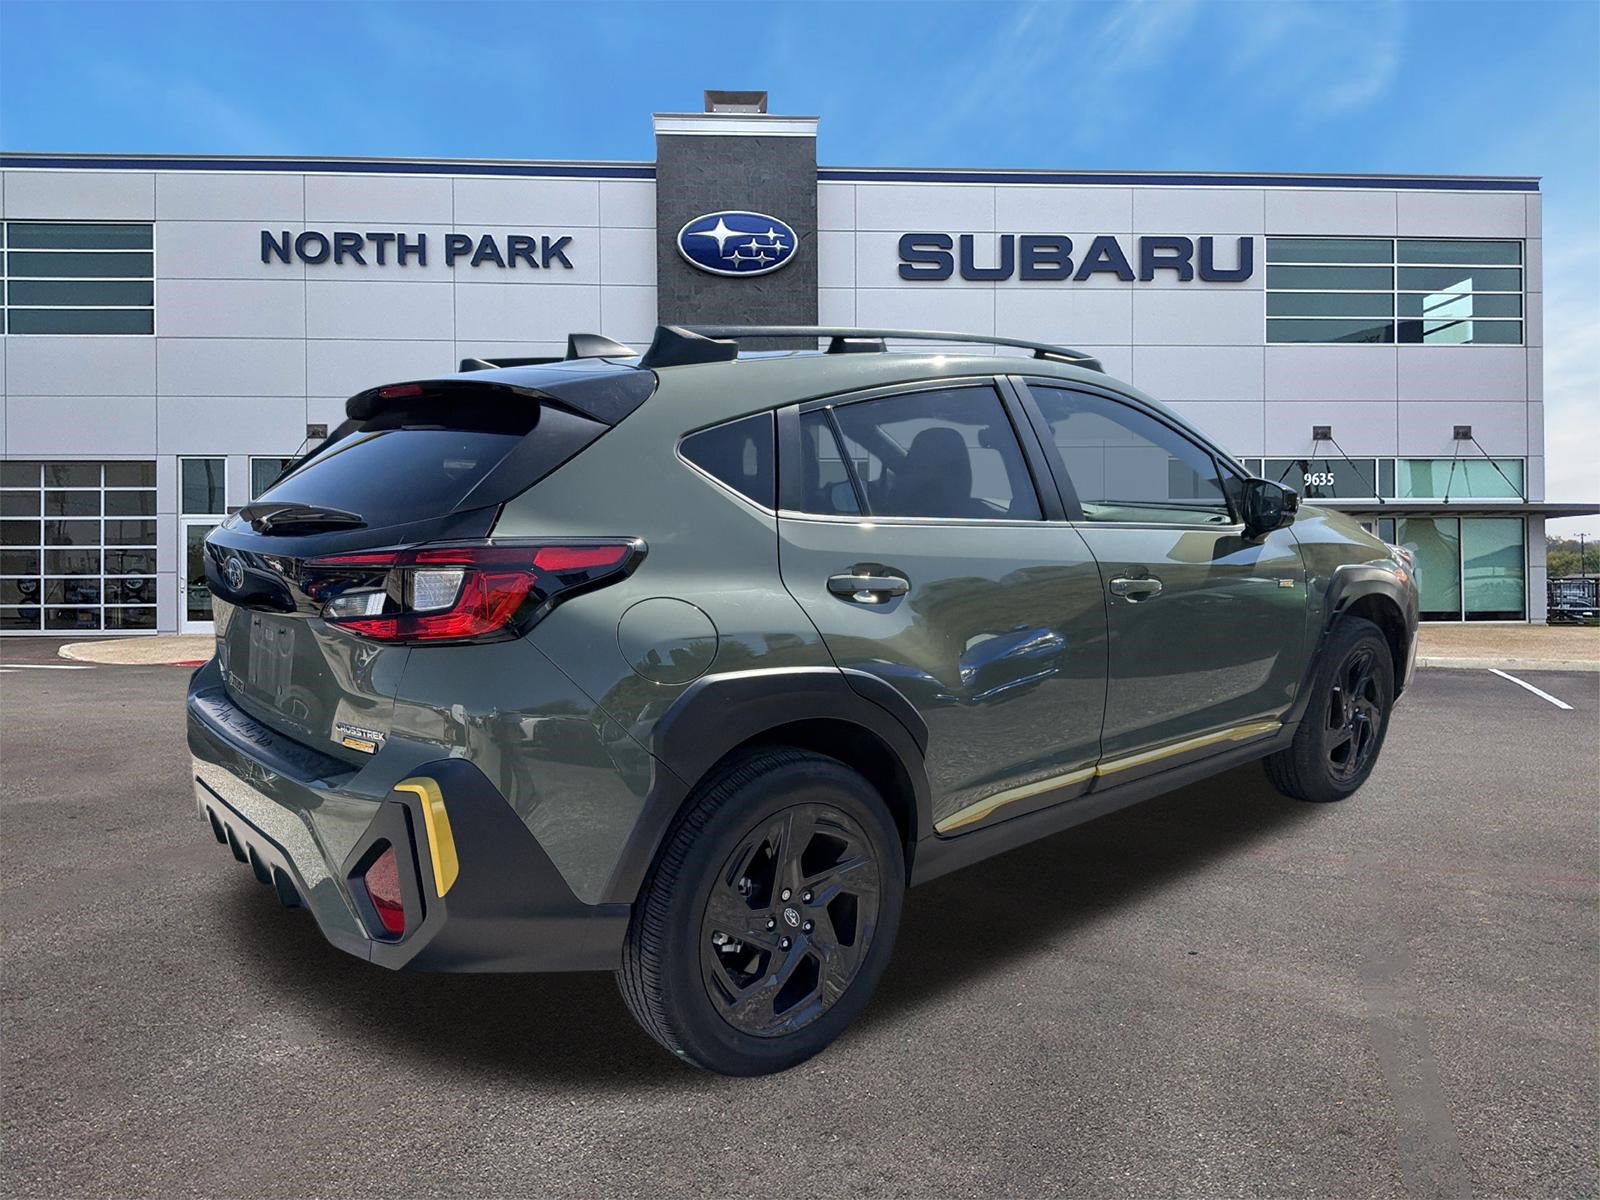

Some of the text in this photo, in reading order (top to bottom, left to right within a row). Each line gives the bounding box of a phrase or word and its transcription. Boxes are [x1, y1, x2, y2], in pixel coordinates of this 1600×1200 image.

[260, 230, 574, 269] NORTH PARK
[897, 233, 1254, 283] SUBARU
[1303, 472, 1335, 486] 9635
